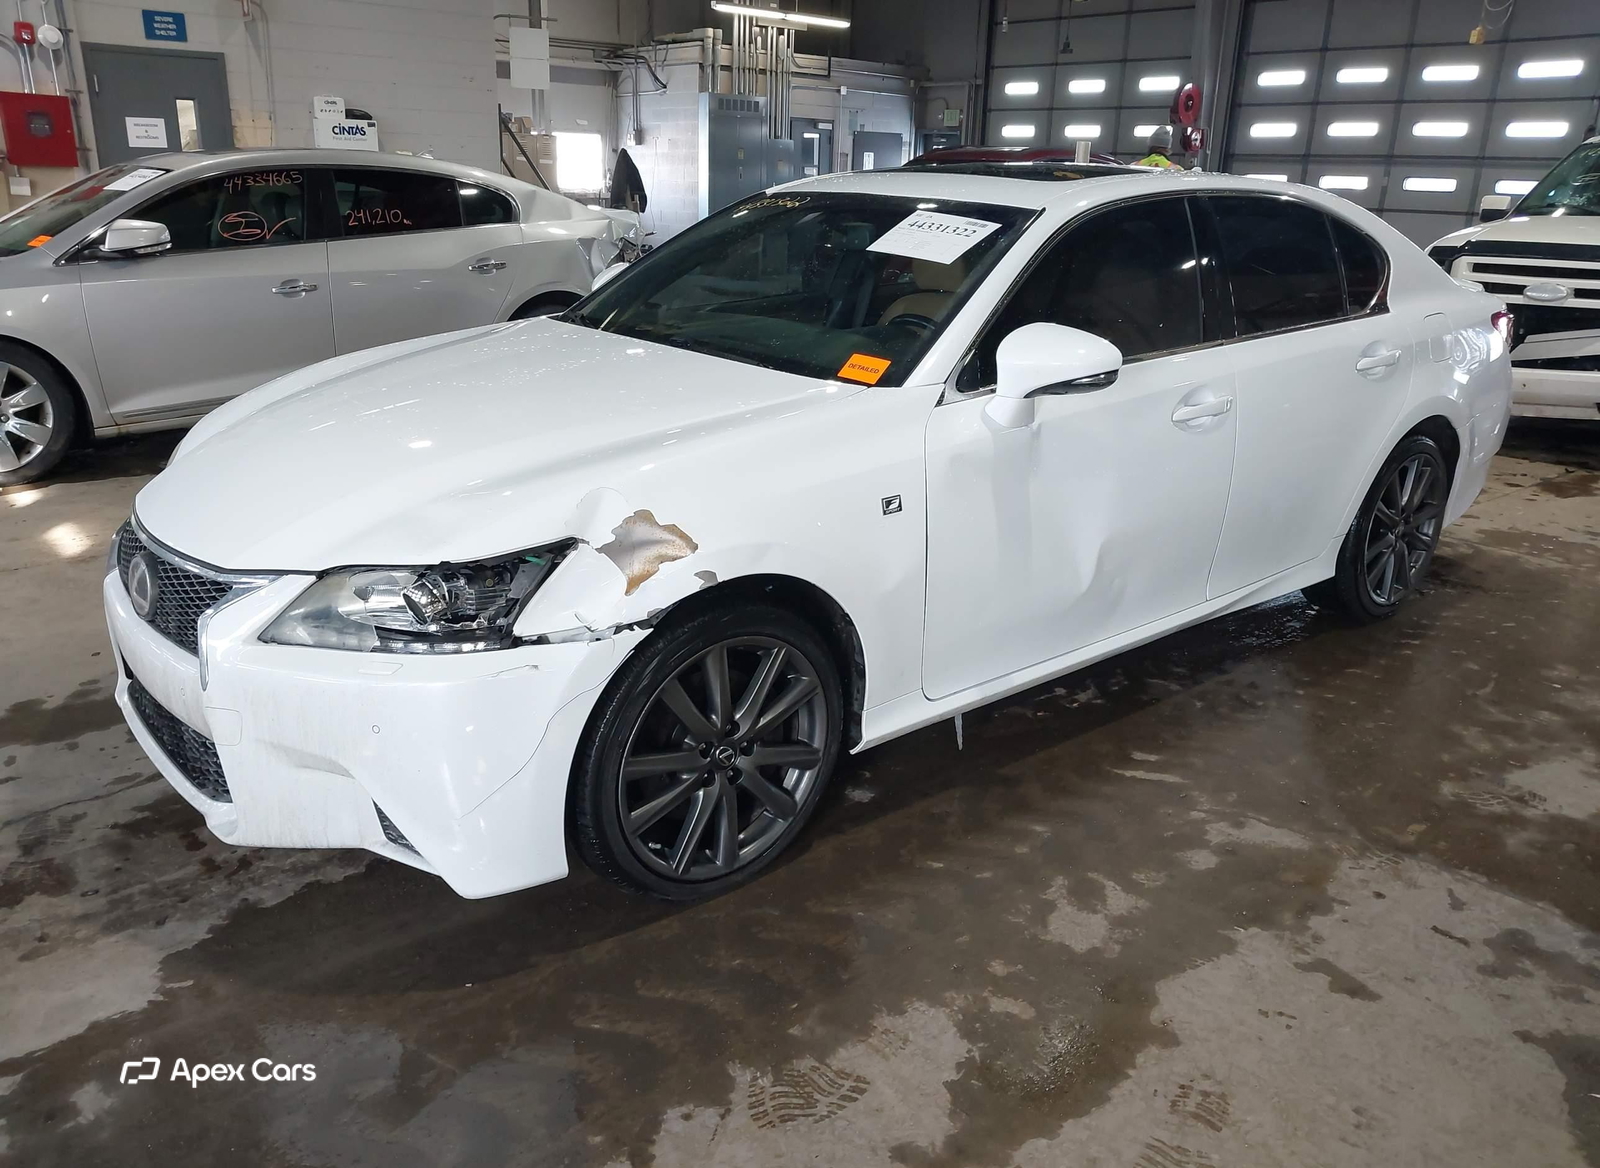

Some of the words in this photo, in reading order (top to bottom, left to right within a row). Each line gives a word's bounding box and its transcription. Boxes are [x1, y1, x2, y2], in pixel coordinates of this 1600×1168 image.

[331, 122, 366, 136] CINTAS
[224, 171, 303, 194] 44334665
[346, 208, 402, 226] 241,210
[907, 220, 977, 238] 44331322
[848, 363, 880, 374] DETAILED
